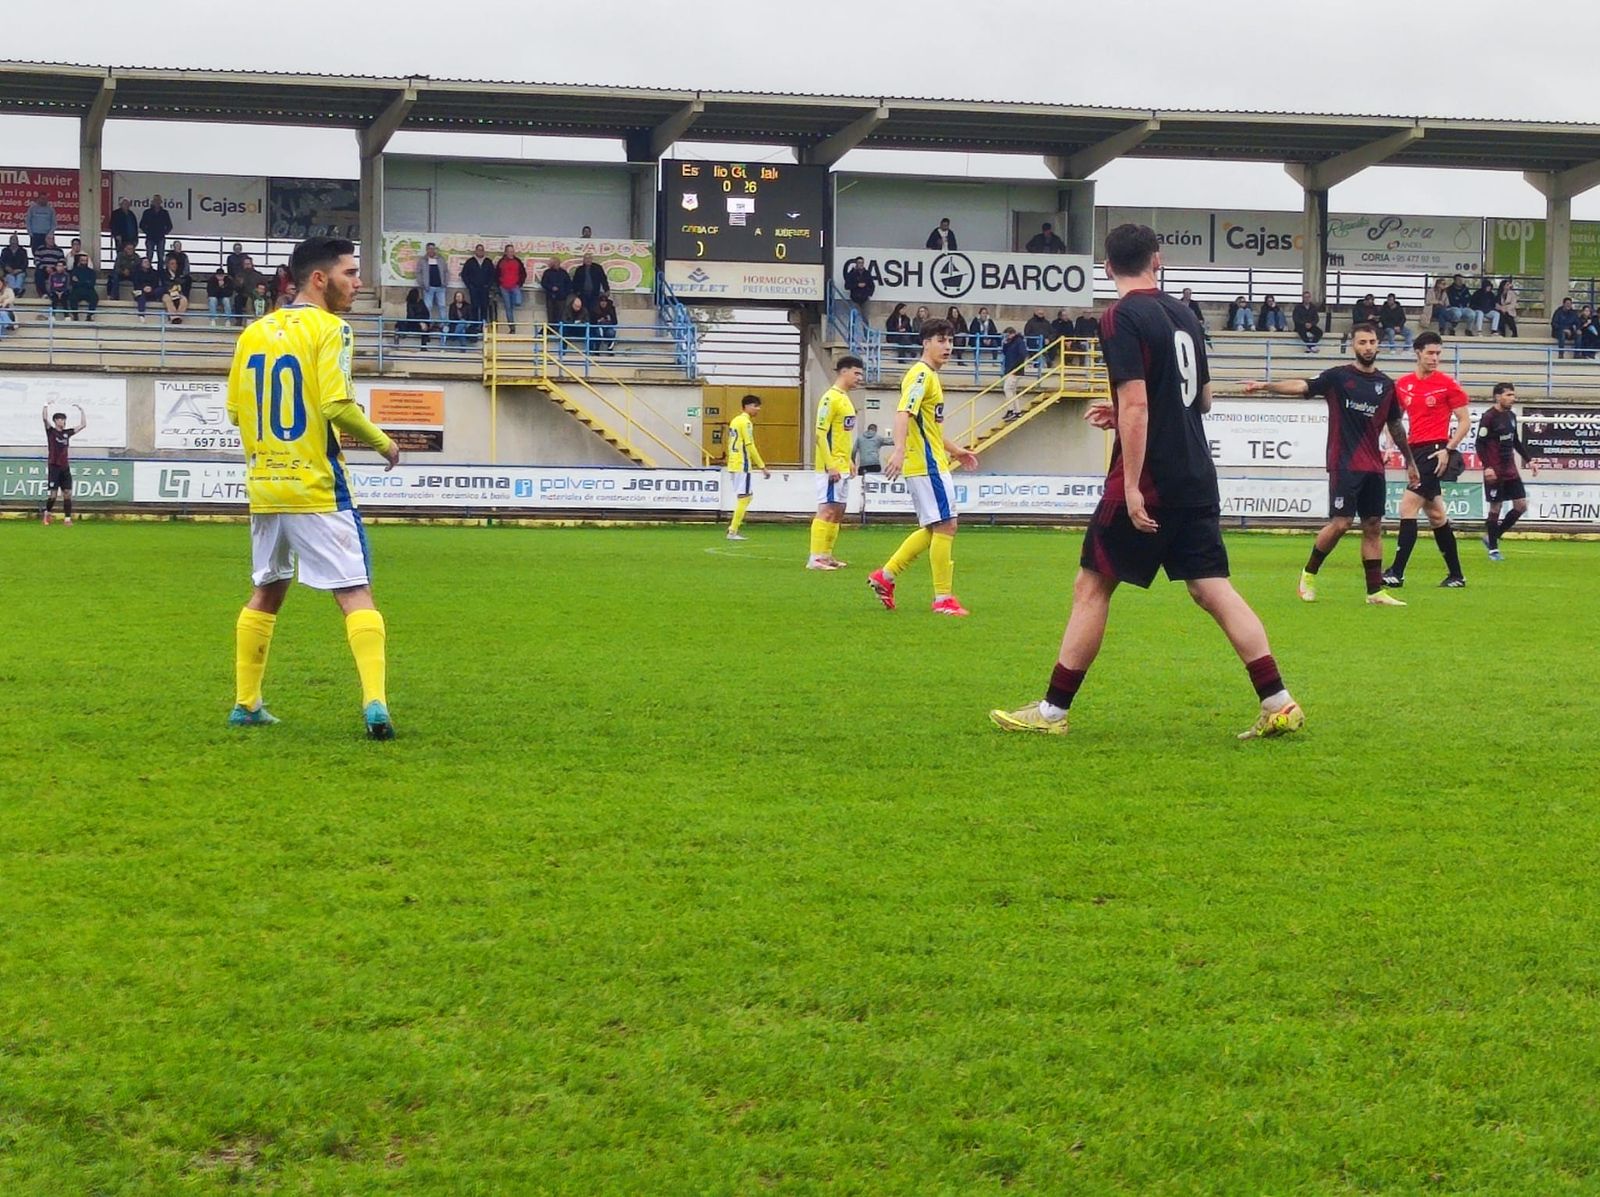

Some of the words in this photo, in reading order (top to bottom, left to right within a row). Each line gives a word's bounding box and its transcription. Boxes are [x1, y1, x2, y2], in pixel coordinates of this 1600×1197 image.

[34, 174, 73, 187] Javier
[200, 197, 262, 216] Cajasol
[1157, 231, 1202, 247] ación
[1361, 253, 1390, 263] CORIA
[981, 263, 1085, 293] BARCO
[1174, 330, 1198, 408] 9
[159, 383, 220, 392] TALLERES
[246, 353, 307, 442] 10
[194, 437, 217, 448] 697
[219, 438, 241, 449] 819
[1247, 440, 1292, 460] TEC
[540, 477, 615, 492] polvero
[979, 482, 1050, 497] polvero
